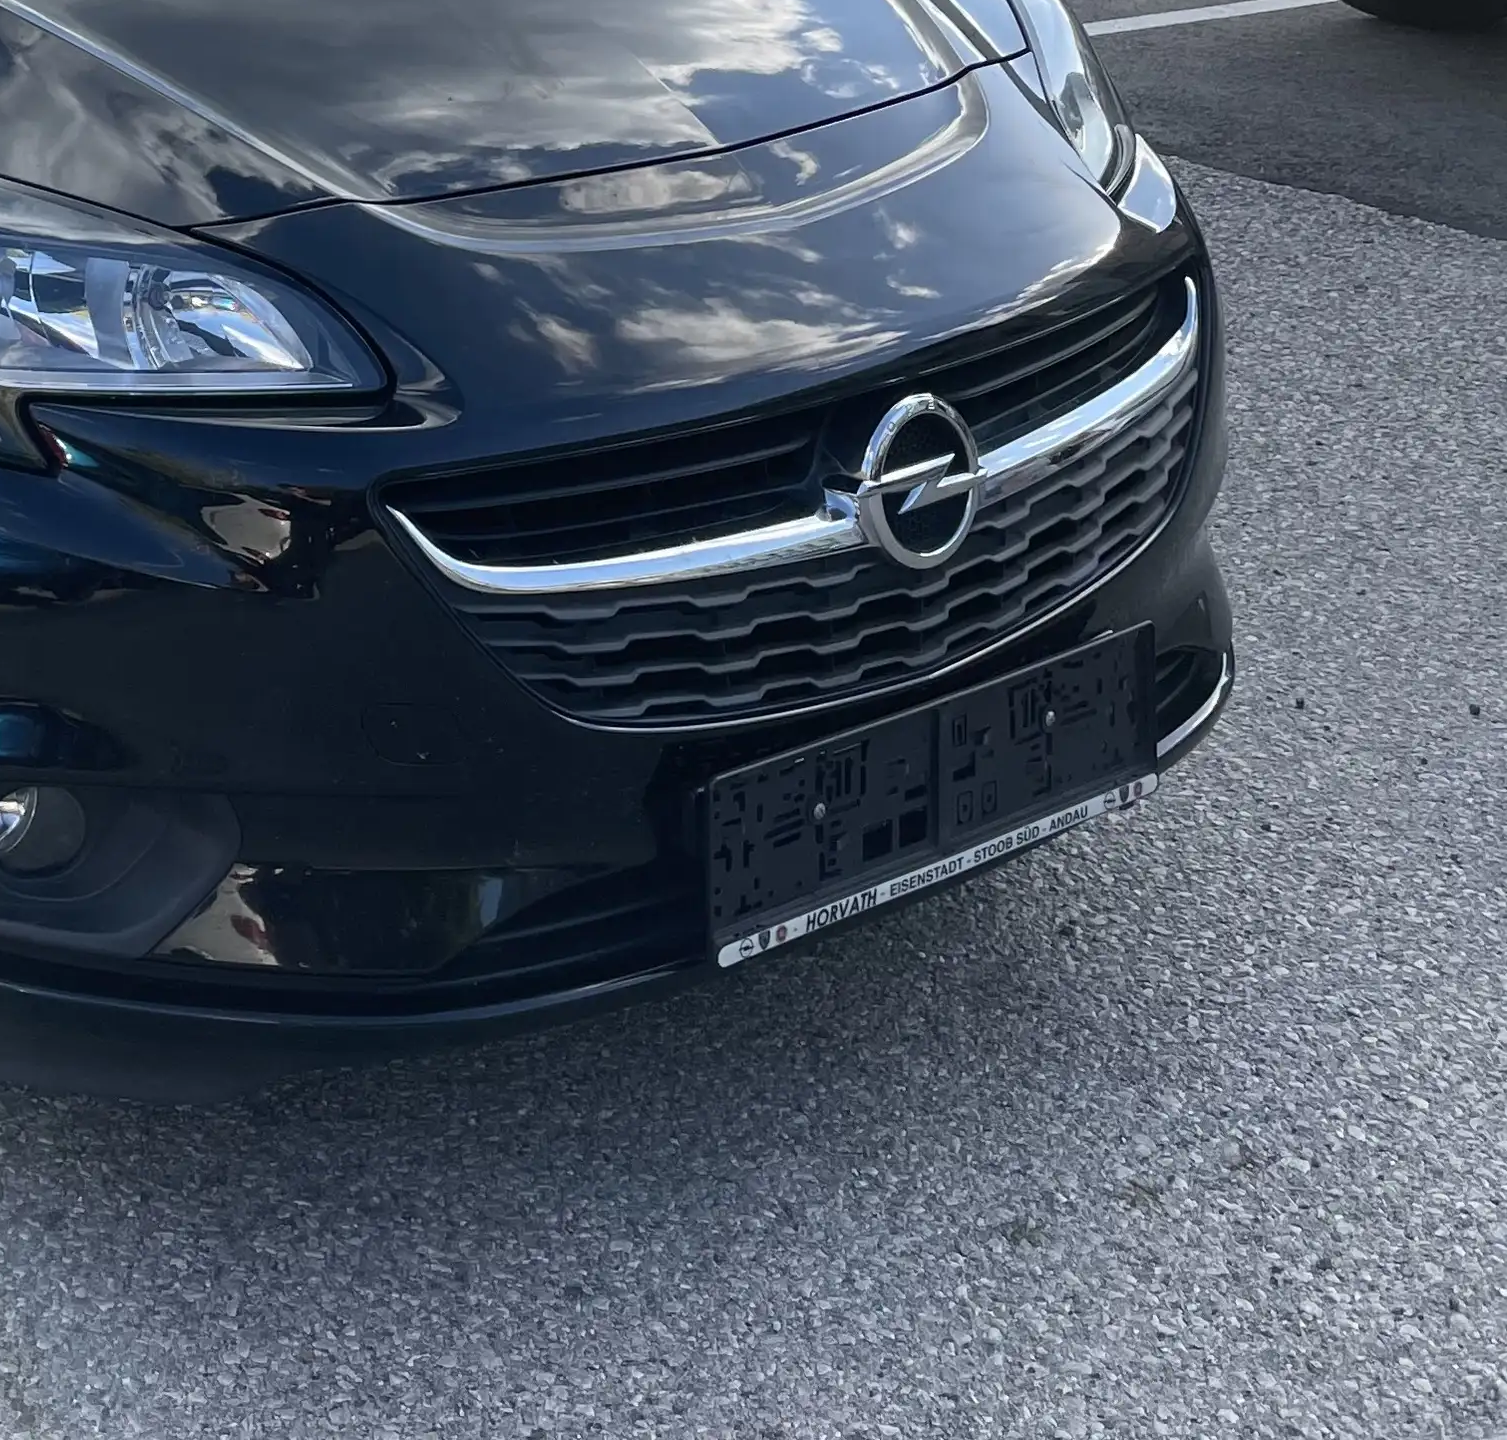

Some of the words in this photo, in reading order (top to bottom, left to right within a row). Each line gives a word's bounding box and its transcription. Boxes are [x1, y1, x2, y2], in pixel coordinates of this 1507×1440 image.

[805, 887, 877, 933] HORVATH
[890, 856, 965, 897] EISENSTADT
[973, 836, 1014, 864] STOOB
[1016, 825, 1041, 847] SÜD
[1049, 805, 1089, 833] ANDAU
